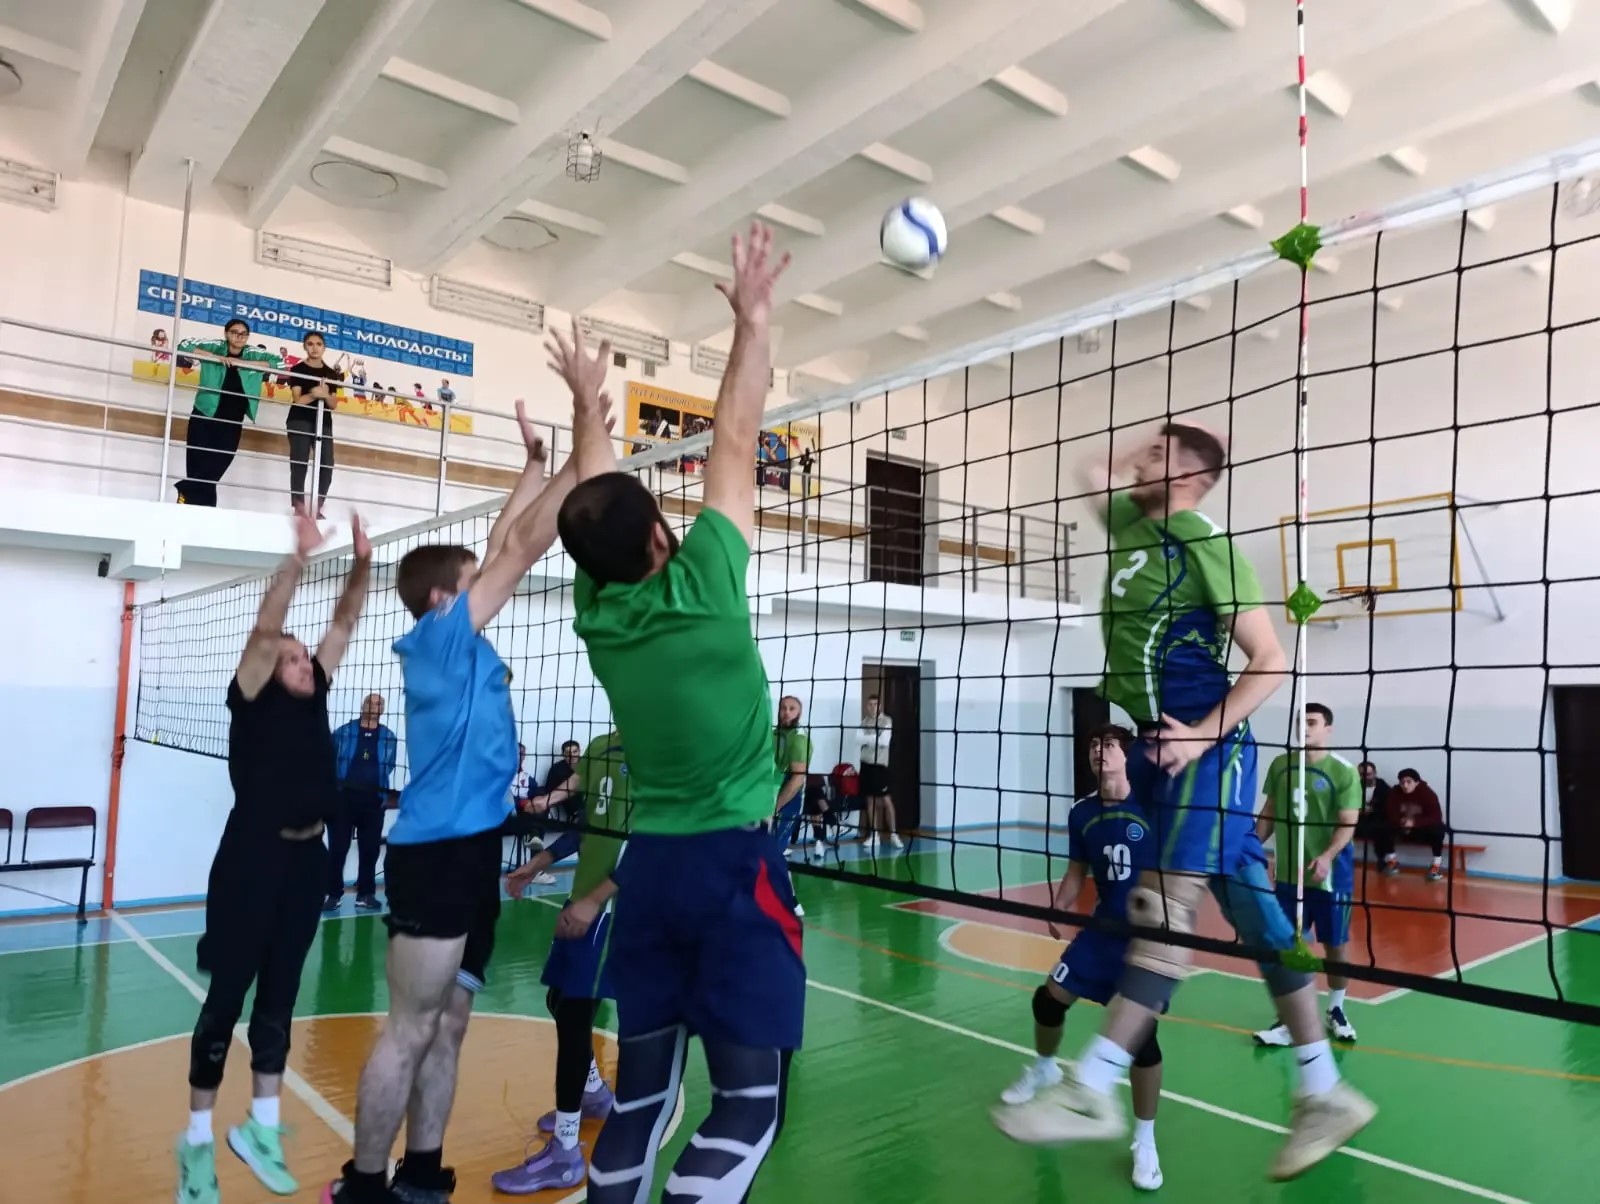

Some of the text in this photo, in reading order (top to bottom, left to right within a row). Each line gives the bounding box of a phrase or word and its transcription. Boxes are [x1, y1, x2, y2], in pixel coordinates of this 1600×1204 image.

[147, 286, 216, 310] СПОРТ
[236, 304, 338, 335] ЗДОРОВЬЕ
[356, 329, 468, 363] МОЛОДОСТЬ!
[1111, 550, 1149, 598] 2
[595, 776, 613, 816] 9
[1103, 843, 1132, 881] 10
